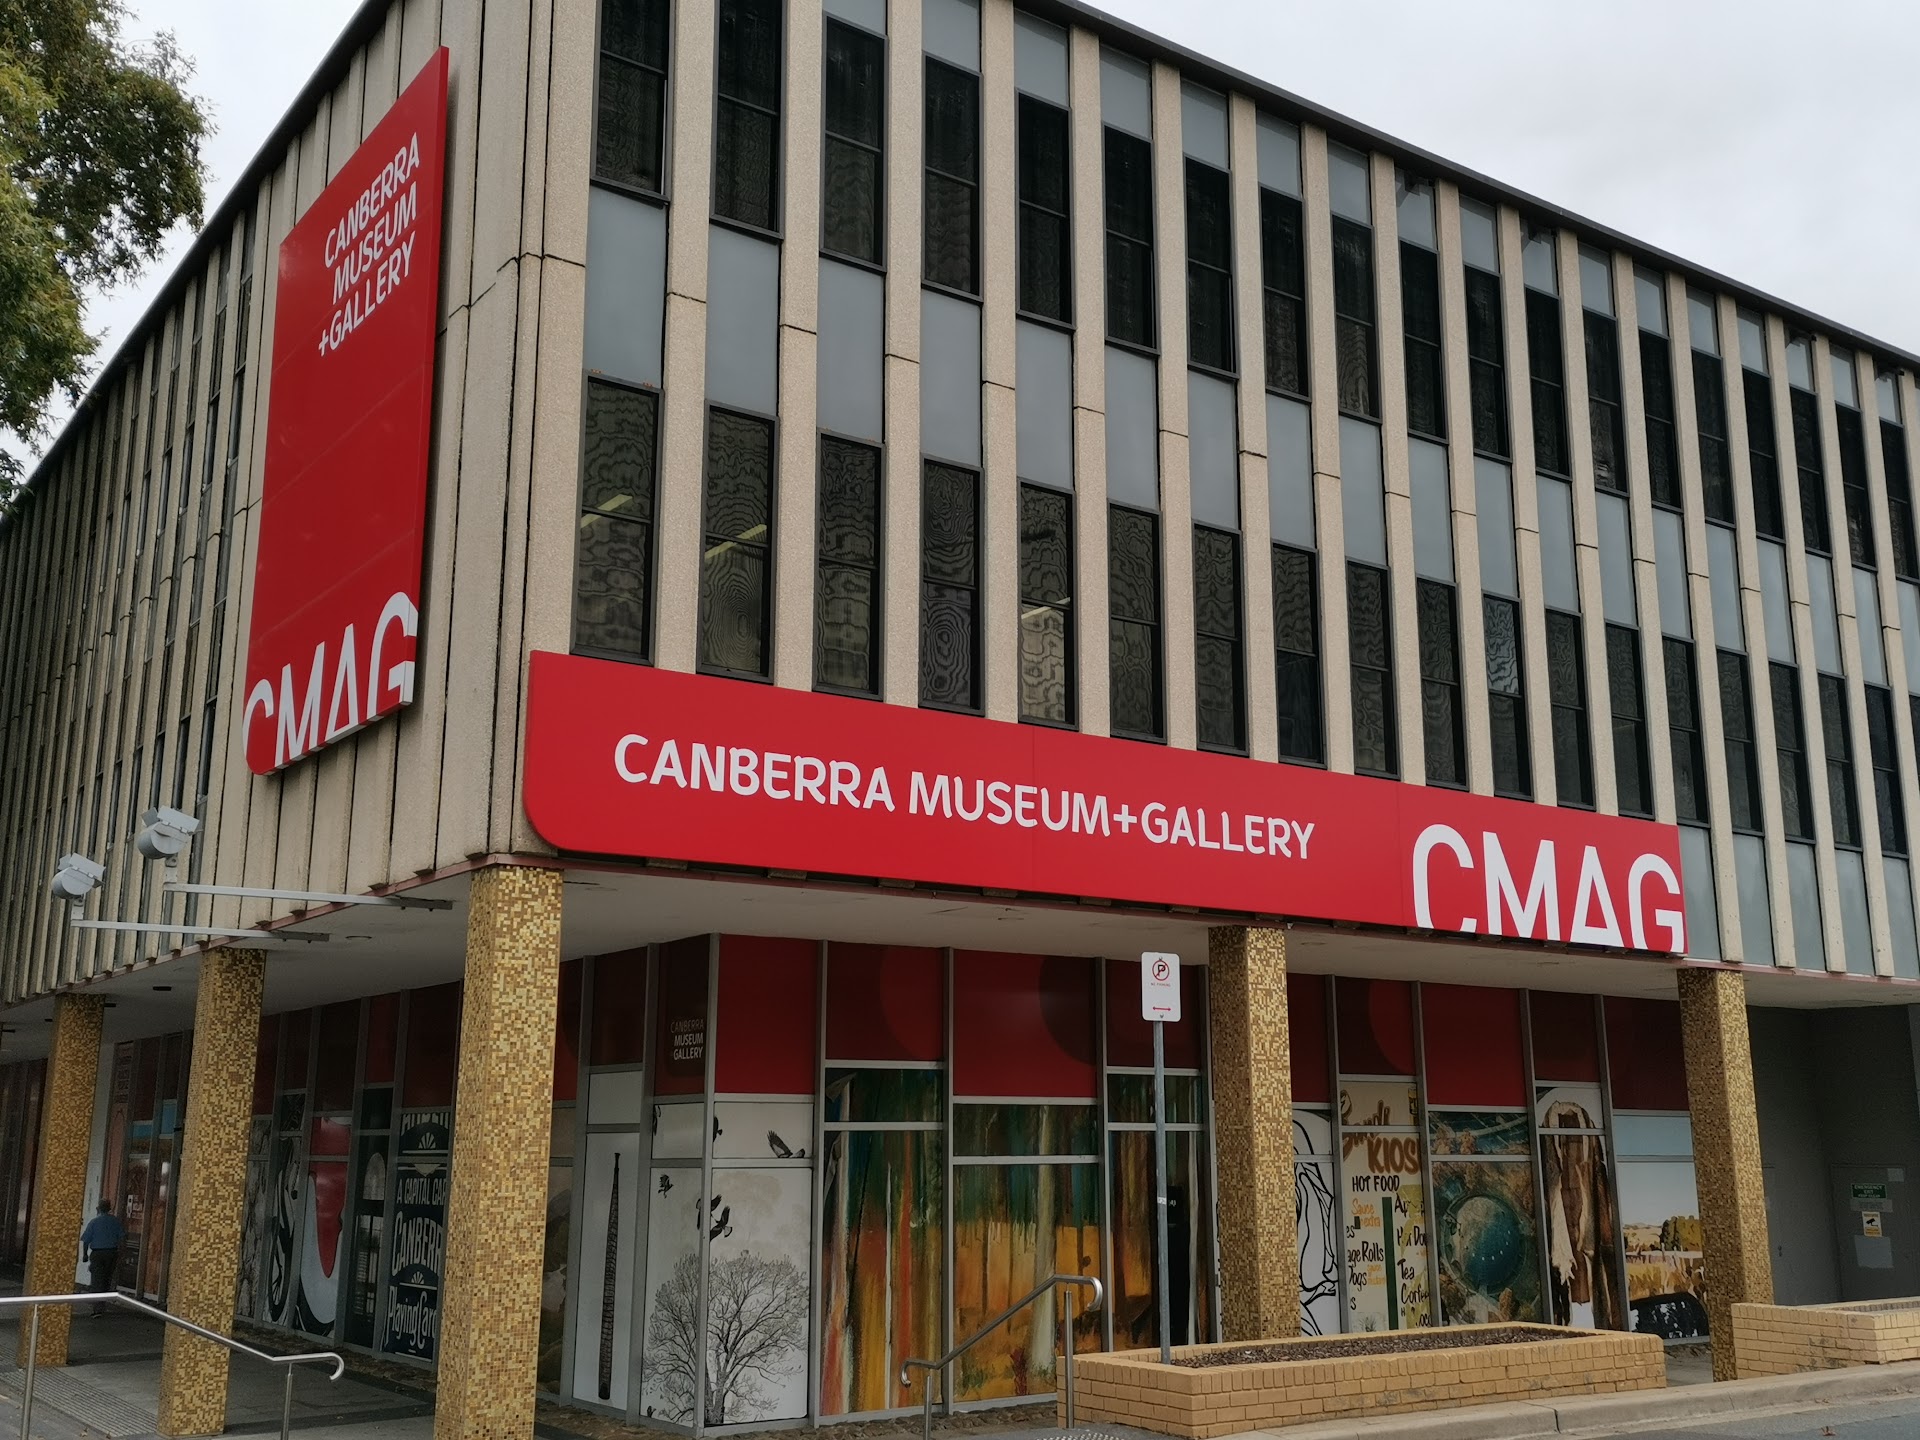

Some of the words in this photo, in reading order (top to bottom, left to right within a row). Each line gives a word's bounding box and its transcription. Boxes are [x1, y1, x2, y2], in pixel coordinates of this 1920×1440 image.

[324, 132, 420, 269] CANBERRA
[332, 181, 417, 305] MUSEUM
[318, 231, 416, 357] +GALLERY
[242, 591, 418, 768] CMAG
[614, 733, 895, 812] CANBERRA
[1412, 823, 1684, 953] CMAG
[670, 1018, 704, 1034] CANBERRA
[674, 1032, 704, 1047] MUSEUM
[673, 1046, 704, 1061] GALLERY
[1367, 1136, 1421, 1175] KIOS
[396, 1178, 403, 1205] A
[404, 1178, 431, 1205] CAPITAL
[1352, 1175, 1371, 1193] HOT
[1374, 1174, 1400, 1193] FOOD
[1362, 1241, 1385, 1262] Rolls
[1397, 1258, 1415, 1280] Tea
[380, 1285, 420, 1351] Playing
